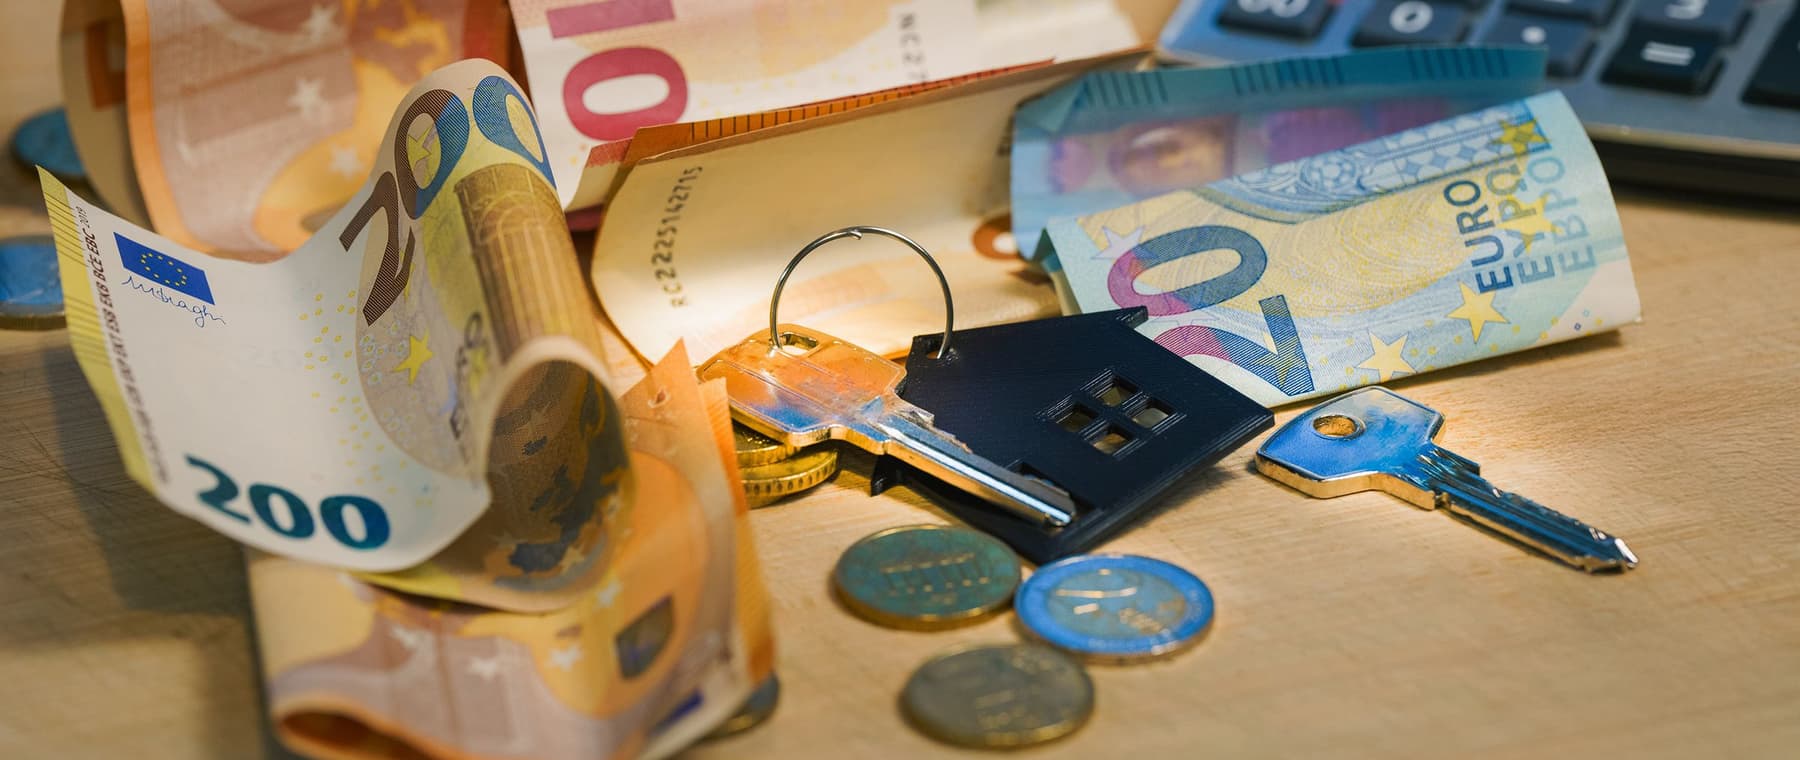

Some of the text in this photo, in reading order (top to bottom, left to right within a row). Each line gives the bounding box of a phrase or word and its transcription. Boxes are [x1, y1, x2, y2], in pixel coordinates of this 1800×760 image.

[82, 228, 100, 256] EBC
[339, 75, 557, 327] 200
[1443, 179, 1514, 294] EURO
[1107, 225, 1315, 397] 20
[184, 453, 390, 551] 200
